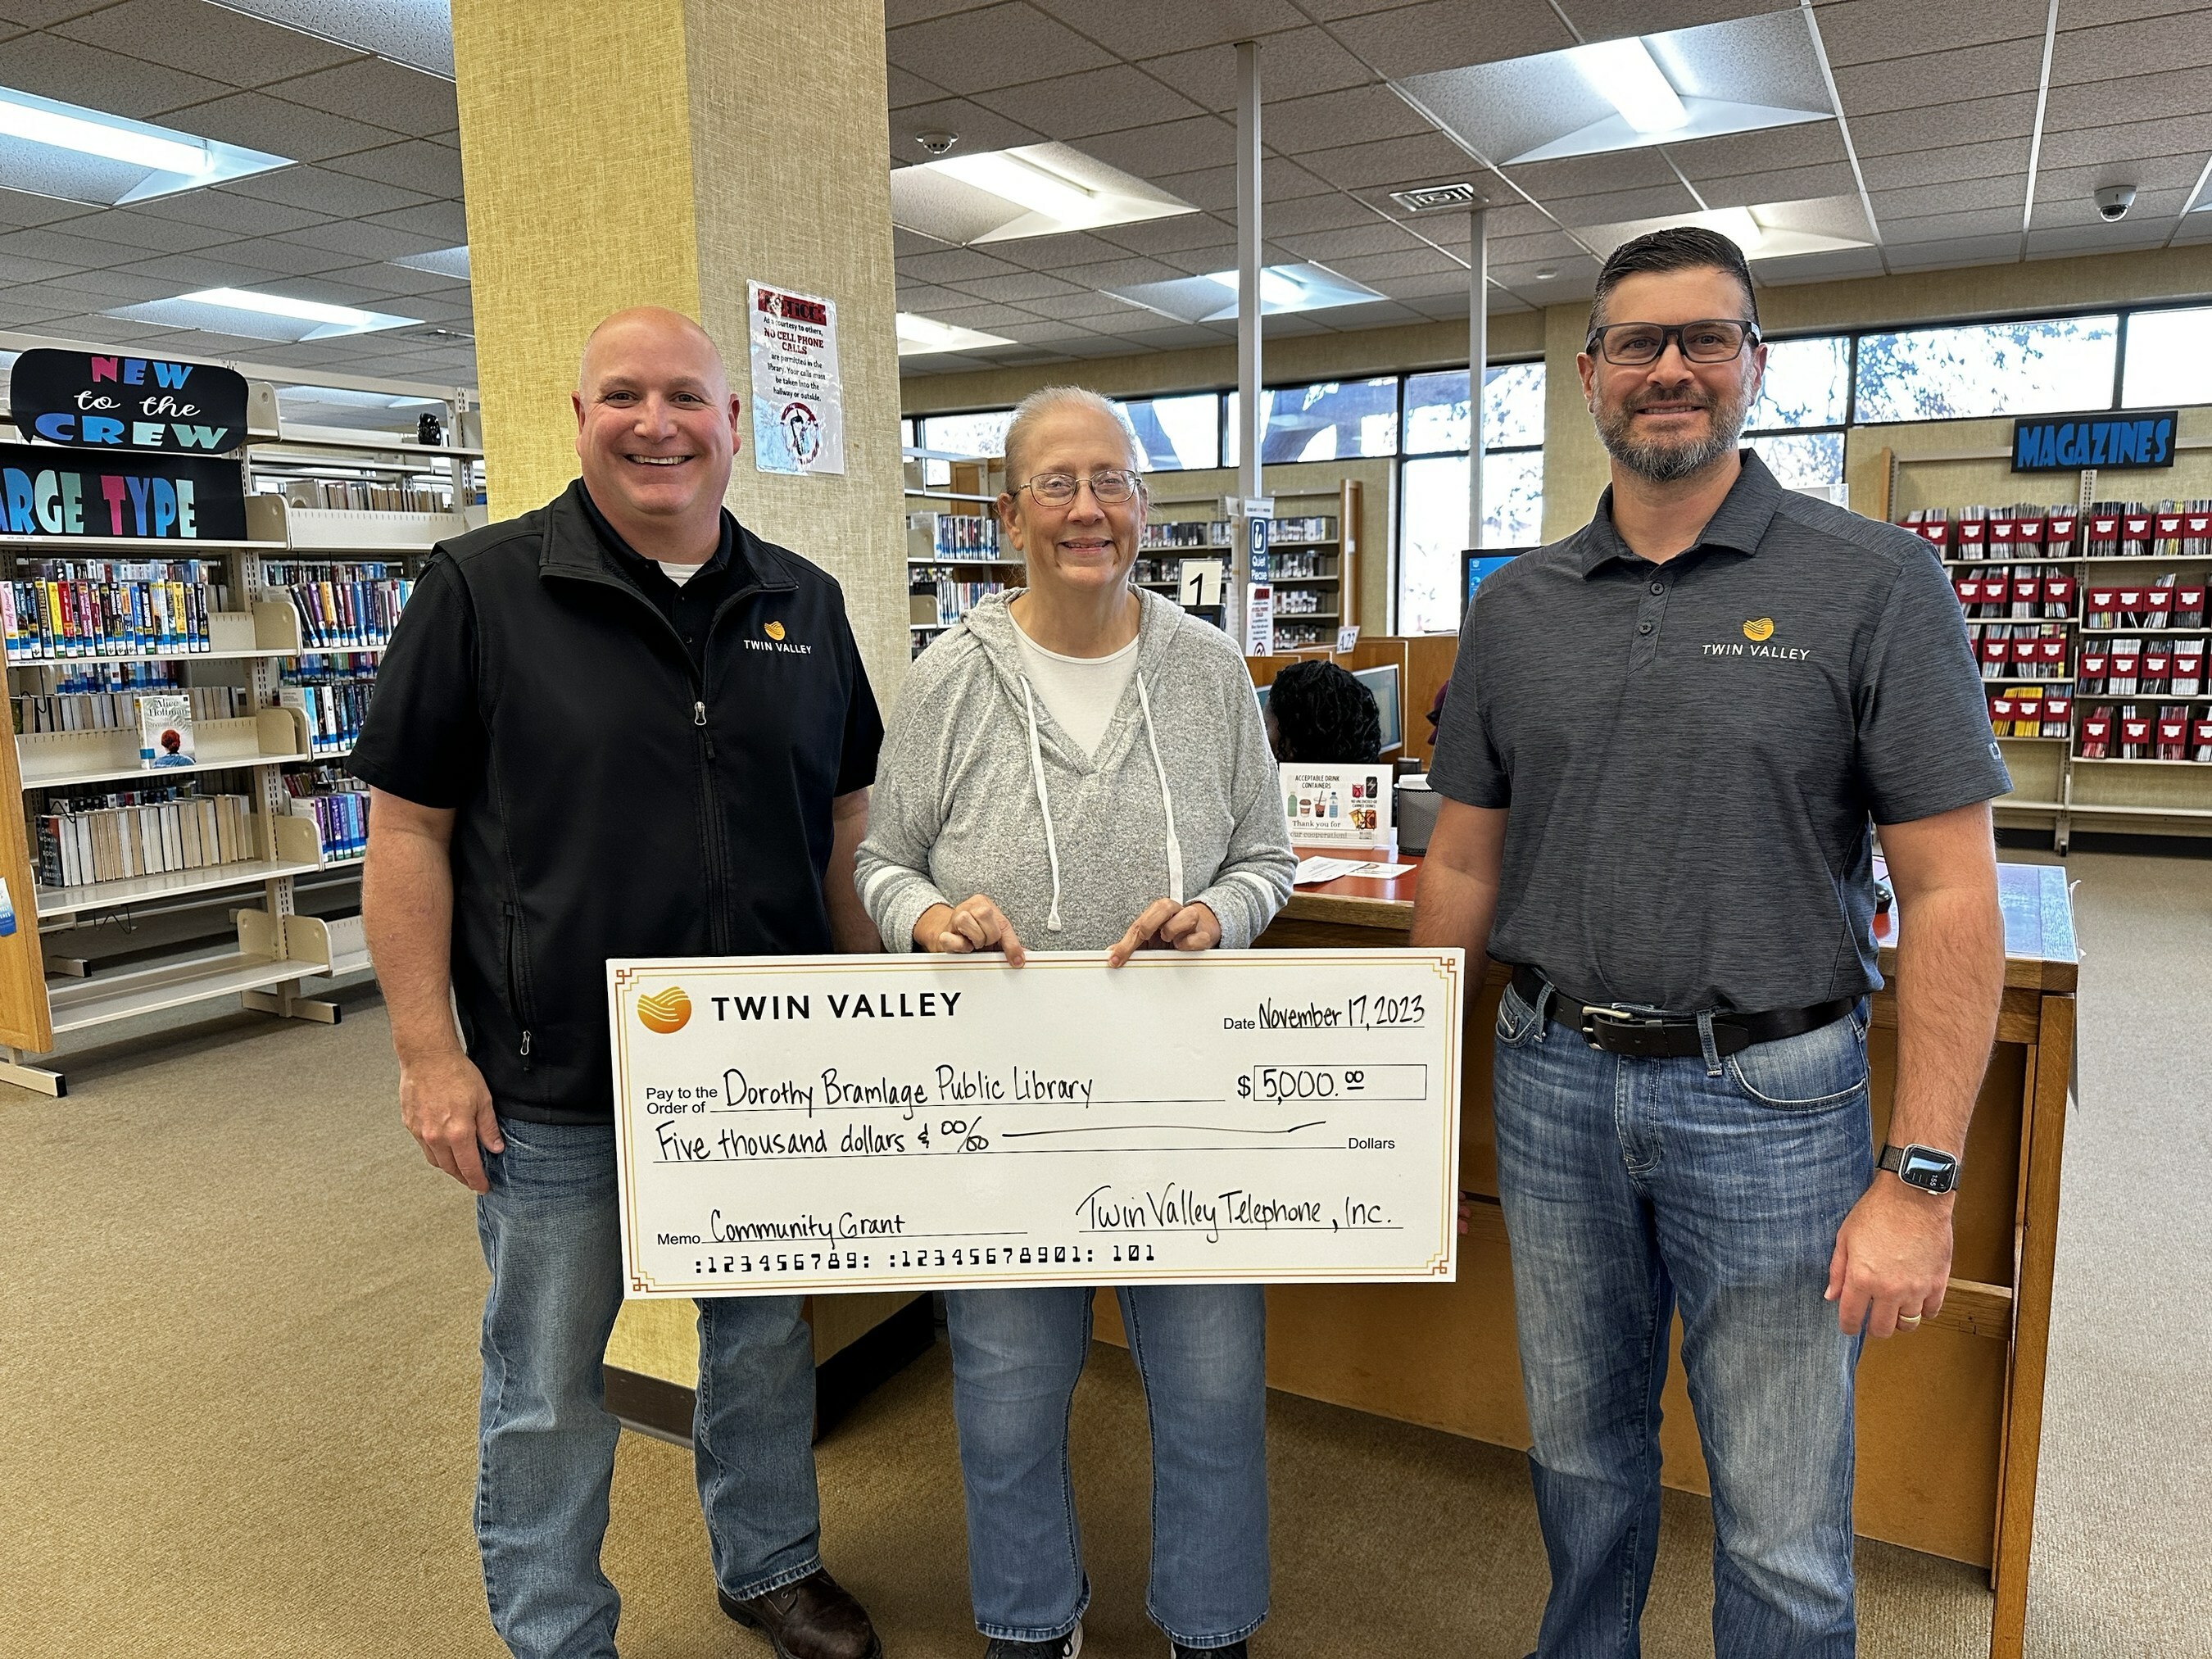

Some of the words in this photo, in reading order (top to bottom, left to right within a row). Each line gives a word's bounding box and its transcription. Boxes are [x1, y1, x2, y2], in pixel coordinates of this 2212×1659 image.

[764, 328, 776, 338] NO
[777, 331, 796, 343] CELL
[797, 335, 824, 348] PHONE
[805, 325, 823, 337] others,
[782, 342, 808, 355] CALLS
[771, 353, 780, 361] are
[814, 360, 823, 369] the
[90, 356, 194, 390] NEW
[786, 367, 799, 375] Your
[800, 369, 812, 378] calls
[775, 375, 782, 384] be
[782, 378, 799, 386] taken
[799, 380, 810, 389] into
[810, 382, 820, 391] the
[74, 389, 121, 412] to
[139, 395, 202, 418] the
[773, 387, 793, 399] hallway
[800, 392, 822, 401] outside.
[35, 413, 229, 451] CREW
[2017, 419, 2172, 468] MAGAZINES
[101, 474, 197, 539] TYPE
[1252, 555, 1266, 567] Quiet
[1251, 569, 1267, 581] Please
[1190, 573, 1203, 605] 1
[744, 640, 773, 651] TWIN
[775, 642, 812, 655] VALLEY
[1338, 632, 1355, 651] A23
[1702, 644, 1743, 655] TWIN
[1750, 645, 1811, 660] VALLEY
[156, 697, 179, 708] Alice
[711, 995, 810, 1022] TWIN
[827, 991, 962, 1020] VALLEY
[1224, 1018, 1255, 1030] Date
[1258, 998, 1342, 1029] November
[1375, 995, 1425, 1024] 2023
[646, 1087, 675, 1103] Pay
[678, 1088, 692, 1099] to
[695, 1086, 718, 1099] the
[723, 1068, 814, 1117] Dorothy
[821, 1068, 928, 1120] Bramlage
[936, 1064, 1004, 1100] Public
[1014, 1068, 1093, 1108] Library
[1237, 1074, 1251, 1099] $
[647, 1101, 685, 1114] Order
[691, 1101, 705, 1113] of
[656, 1121, 710, 1161] Five
[718, 1127, 827, 1154] thousand
[841, 1124, 905, 1154] dollars
[1349, 1137, 1395, 1149] Dollars
[1076, 1185, 1145, 1231] Twin
[1147, 1182, 1219, 1243] Valley
[1344, 1196, 1392, 1225] Inc.
[657, 1233, 700, 1245] Memo
[711, 1209, 835, 1249] Community
[839, 1212, 906, 1238] Grant
[1113, 1244, 1155, 1262] 101
